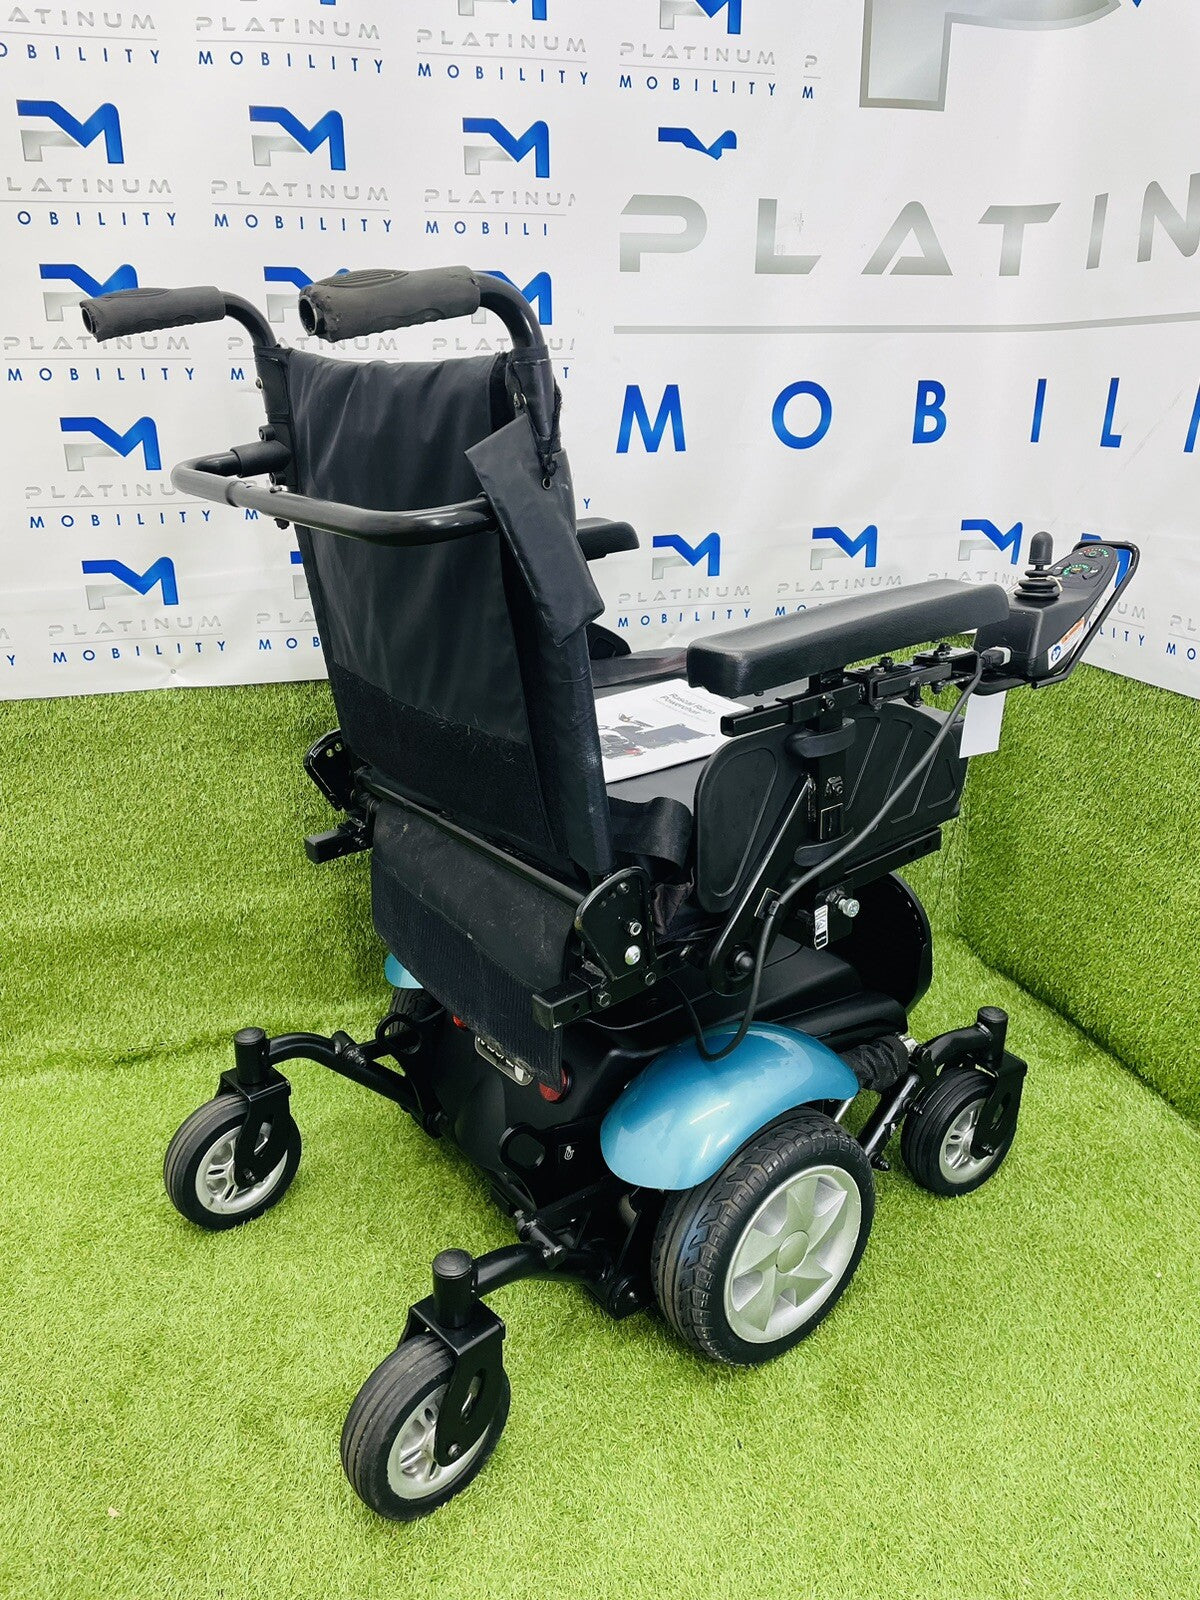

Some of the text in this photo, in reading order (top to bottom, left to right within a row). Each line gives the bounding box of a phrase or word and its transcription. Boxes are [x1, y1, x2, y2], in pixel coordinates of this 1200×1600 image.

[195, 17, 381, 40] PLATINUM
[417, 29, 587, 53] PLATINUM
[198, 51, 383, 74] MOBILITY
[619, 42, 776, 66] PLATINUM
[418, 63, 589, 86] MOBILITY
[619, 74, 776, 97] MOBILITY
[210, 180, 390, 202] PLATINUM
[214, 213, 392, 233] MOBILITY
[3, 336, 190, 351] PLATINUM
[7, 367, 195, 382] MOBILITY
[29, 509, 213, 529] MOBILITY
[618, 584, 751, 604] PLATINUM
[776, 575, 902, 594] PLATINUM
[49, 615, 223, 638] PLATINUM
[617, 608, 752, 628] MOBILITY
[52, 641, 226, 664] MOBILITY
